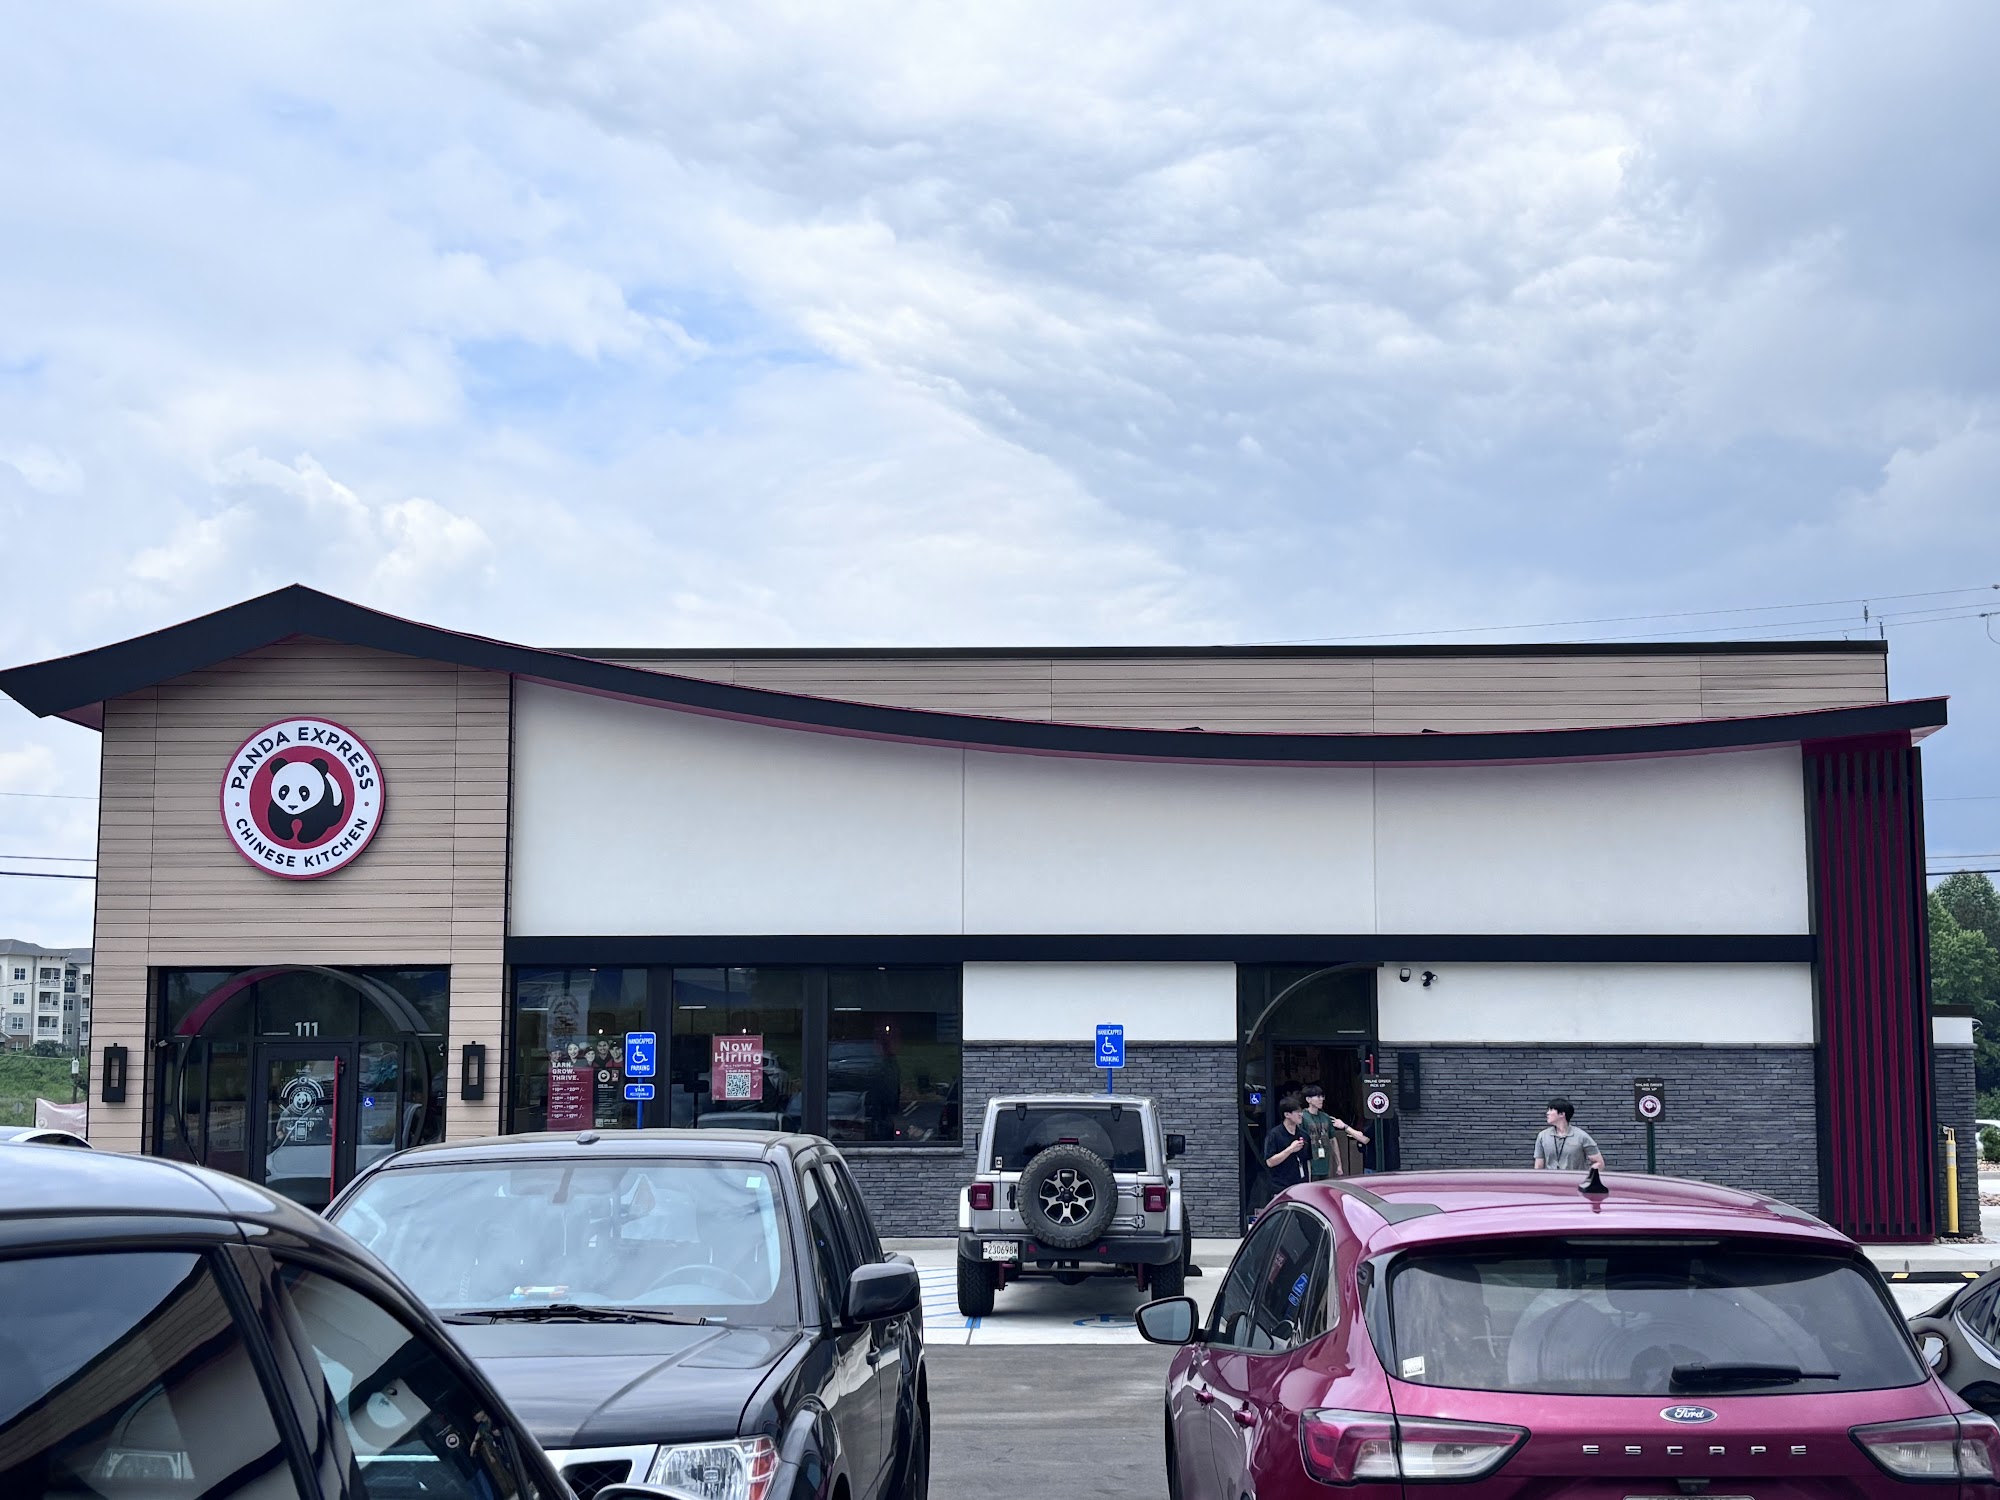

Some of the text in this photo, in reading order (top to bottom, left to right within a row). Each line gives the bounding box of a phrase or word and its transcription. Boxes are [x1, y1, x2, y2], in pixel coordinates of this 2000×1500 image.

[231, 727, 374, 790] PANDA EXPRESS
[236, 818, 368, 868] CHINESE KITCHEN
[294, 1021, 319, 1037] 111
[720, 1041, 753, 1052] Now
[714, 1052, 762, 1065] Hiring
[1674, 1407, 1705, 1419] Ford
[1582, 1445, 1807, 1455] ESCAPE
